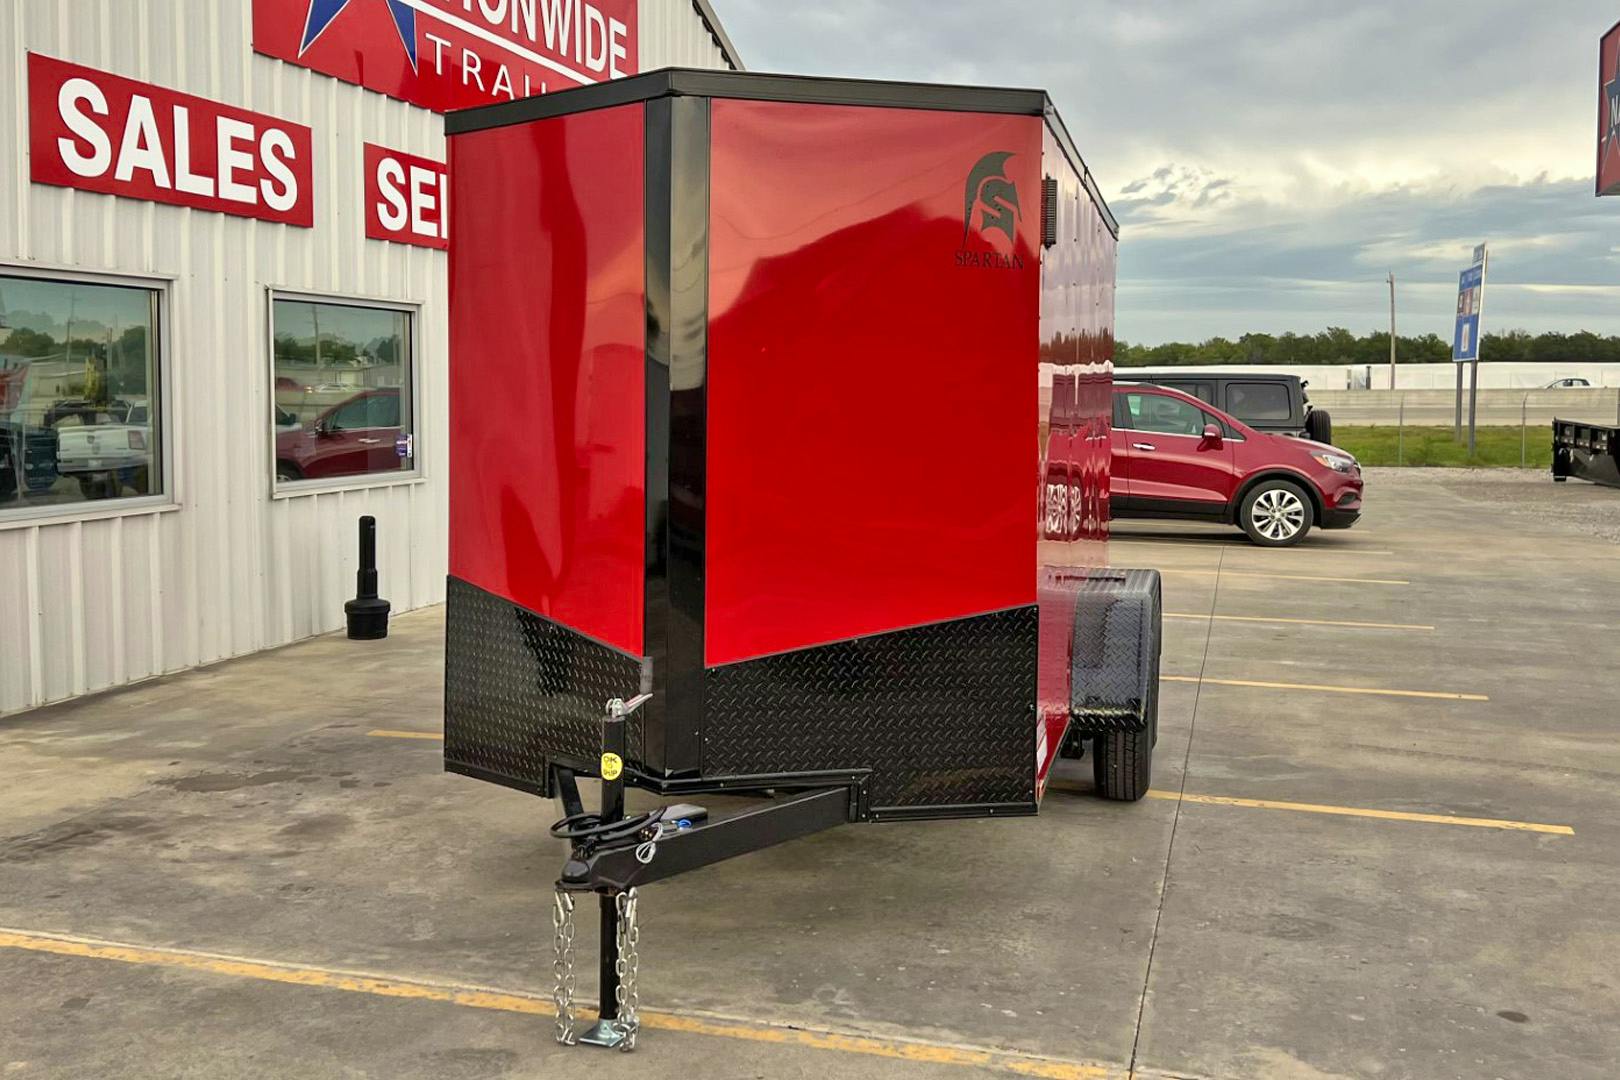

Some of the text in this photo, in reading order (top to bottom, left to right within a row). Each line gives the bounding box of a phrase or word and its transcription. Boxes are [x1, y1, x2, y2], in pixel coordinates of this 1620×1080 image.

[57, 77, 298, 212] SALES
[376, 157, 448, 240] SE
[954, 249, 1025, 270] SPARTAN
